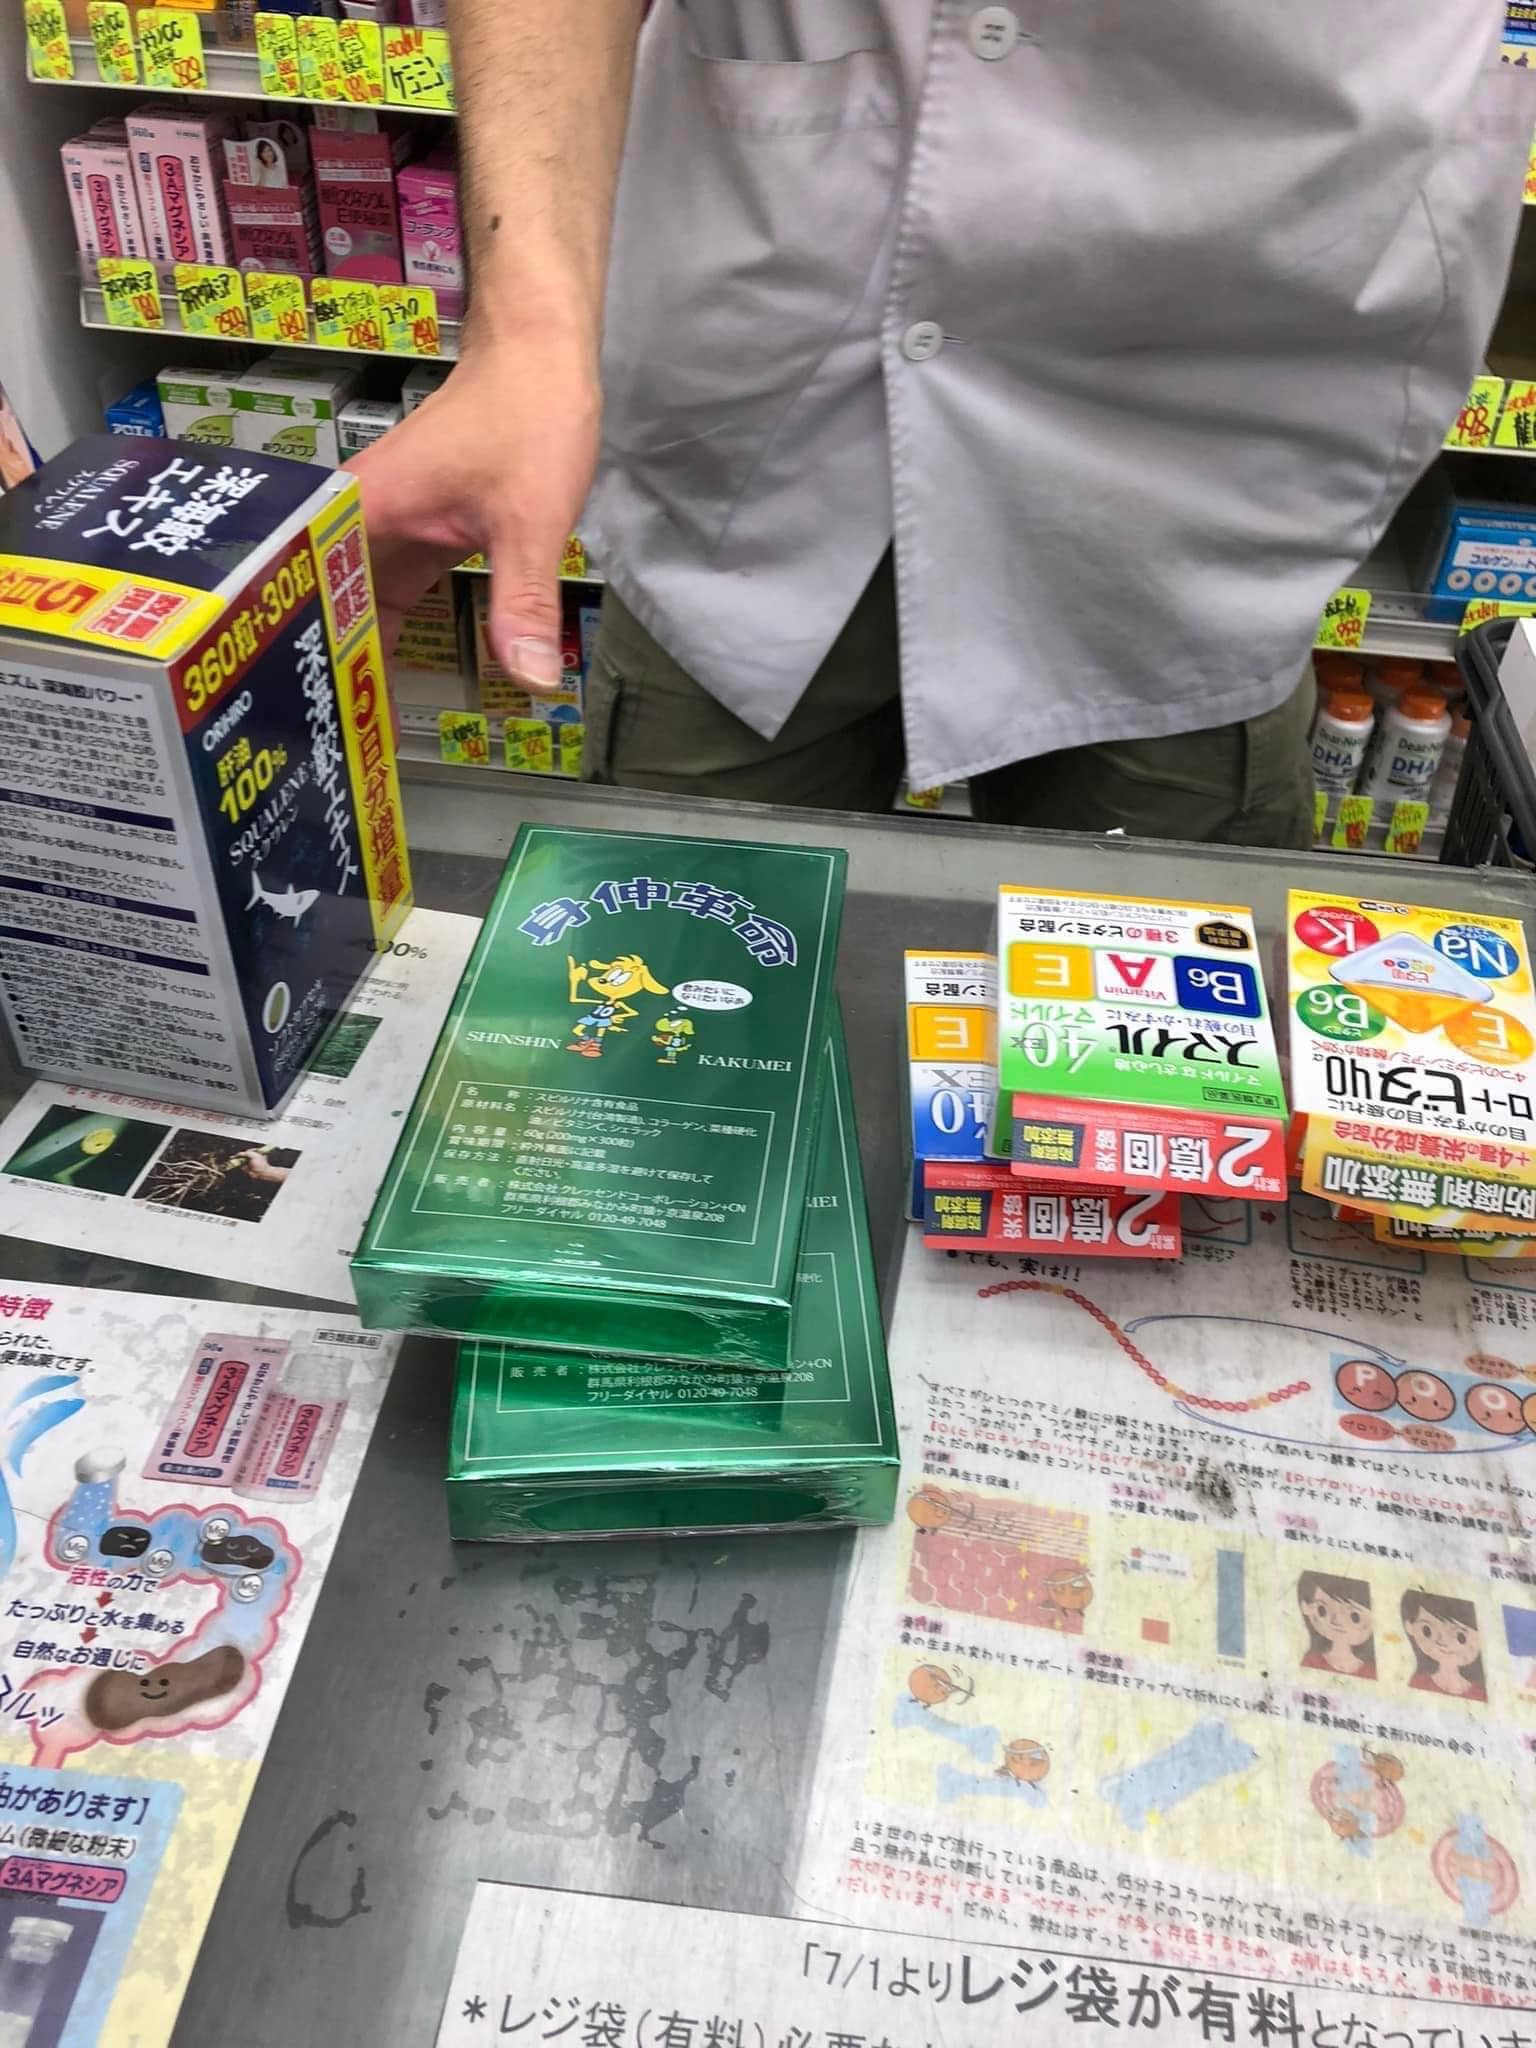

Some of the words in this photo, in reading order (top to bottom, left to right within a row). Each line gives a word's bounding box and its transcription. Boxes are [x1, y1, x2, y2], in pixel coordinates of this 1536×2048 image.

[202, 689, 254, 752] ORIHIRO
[1313, 746, 1354, 768] DHA
[1392, 756, 1439, 775] DHA
[218, 743, 289, 825] 100%
[518, 875, 799, 968] 身伸革命
[1020, 918, 1180, 944] 3種のビタミン配合
[1321, 918, 1360, 952] K
[1033, 953, 1071, 988] E
[1107, 953, 1158, 988] A
[1441, 932, 1512, 978] Na
[1104, 985, 1168, 1002] Vitamin
[1189, 967, 1248, 1007] B6
[594, 1004, 614, 1018] 10
[1009, 1004, 1096, 1024] マイルド
[1106, 1008, 1257, 1038] 目の疲れ・かすみに
[1309, 990, 1370, 1031] B6
[935, 1016, 969, 1050] E
[1106, 1024, 1261, 1070] スマイル
[1471, 1009, 1510, 1051] E
[466, 1031, 562, 1050] SHINSHIN
[697, 1054, 793, 1073] KAKUMEI
[1023, 1021, 1099, 1075] 40
[1328, 1097, 1528, 1143] 目のかすみ・目の疲れに
[1470, 1086, 1534, 1121] ロート
[1095, 1128, 1118, 1173] 突破
[1333, 1118, 1531, 1170] +4種の栄養成分配合
[500, 1203, 585, 1222] フリーダイヤル
[587, 1211, 667, 1230] 0120-49-7048
[0, 1294, 53, 1321] 特徴
[317, 1330, 379, 1349] 第3類医薬品
[1354, 1366, 1378, 1387] P
[585, 1388, 674, 1403] フリーダイヤル
[677, 1386, 759, 1400] 0120-49-7048
[67, 1567, 159, 1594] 活性の力で
[13, 1640, 148, 1671] 自然なお通じに
[4, 1867, 119, 1897] 3Aマグネシア
